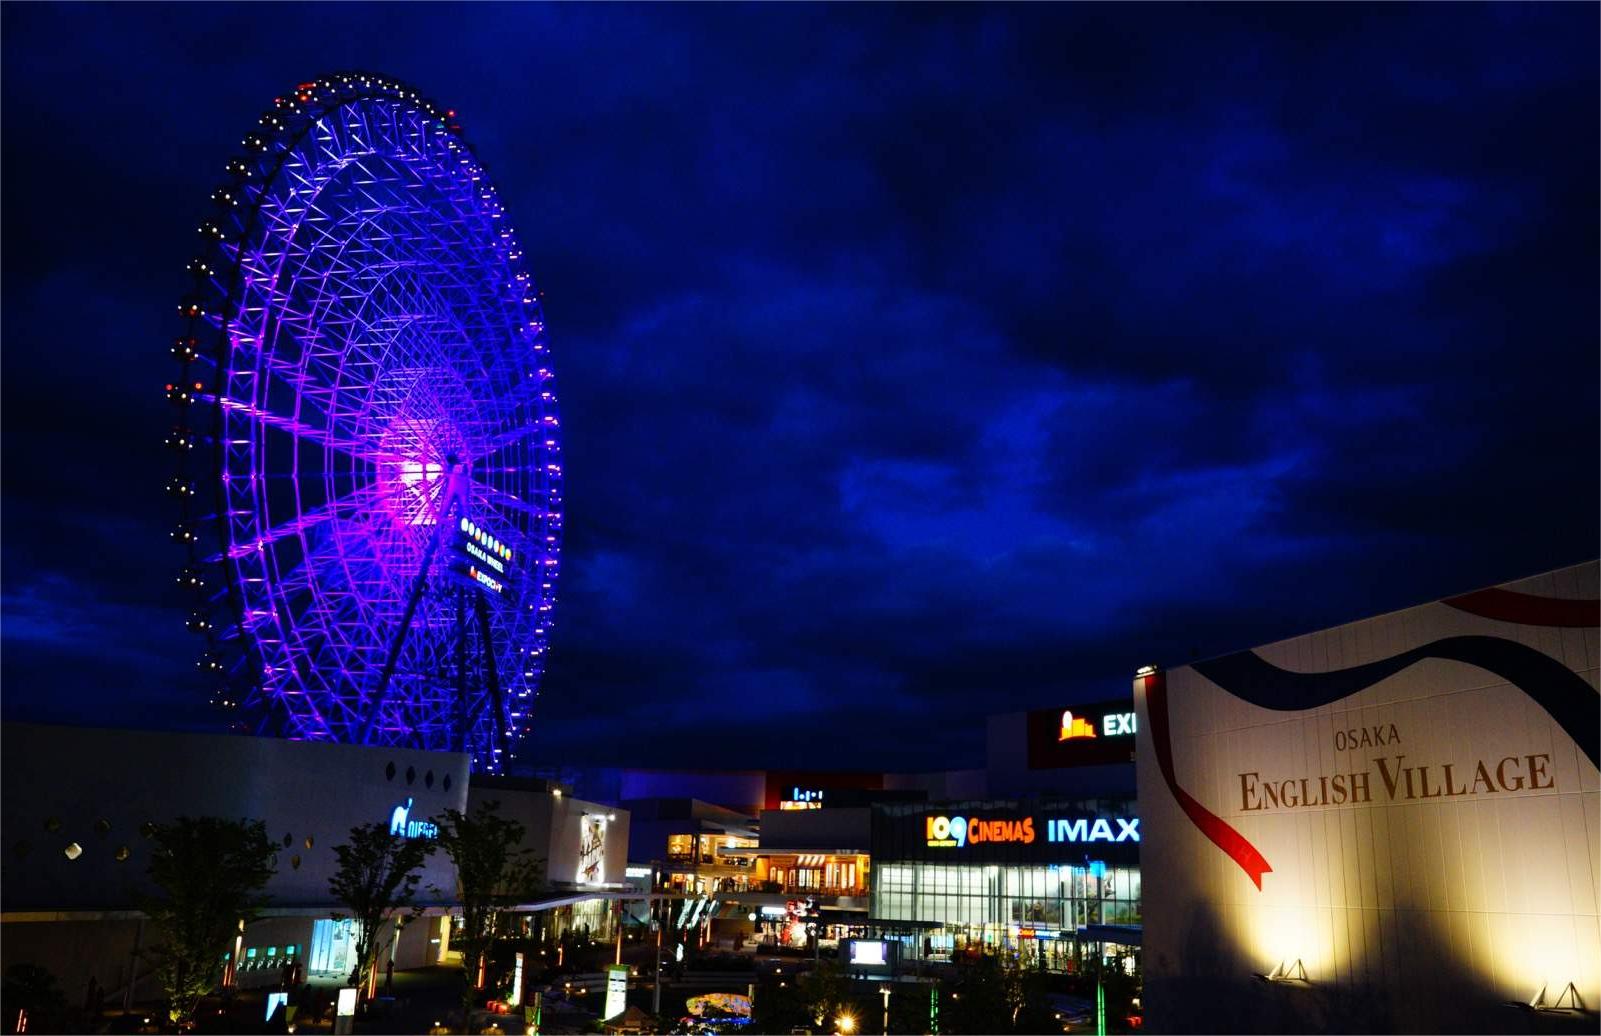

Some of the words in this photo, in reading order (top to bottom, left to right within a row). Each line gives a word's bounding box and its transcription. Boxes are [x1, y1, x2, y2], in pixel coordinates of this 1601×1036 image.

[466, 542, 487, 562] OSAKA
[486, 554, 504, 573] WHEEL
[1335, 723, 1401, 752] OSAKA
[1238, 771, 1374, 811] ENGLISH
[1372, 753, 1555, 801] VILLAGE
[927, 816, 967, 847] 109
[967, 817, 1035, 844] CINEMAS
[1048, 818, 1140, 842] IMAX
